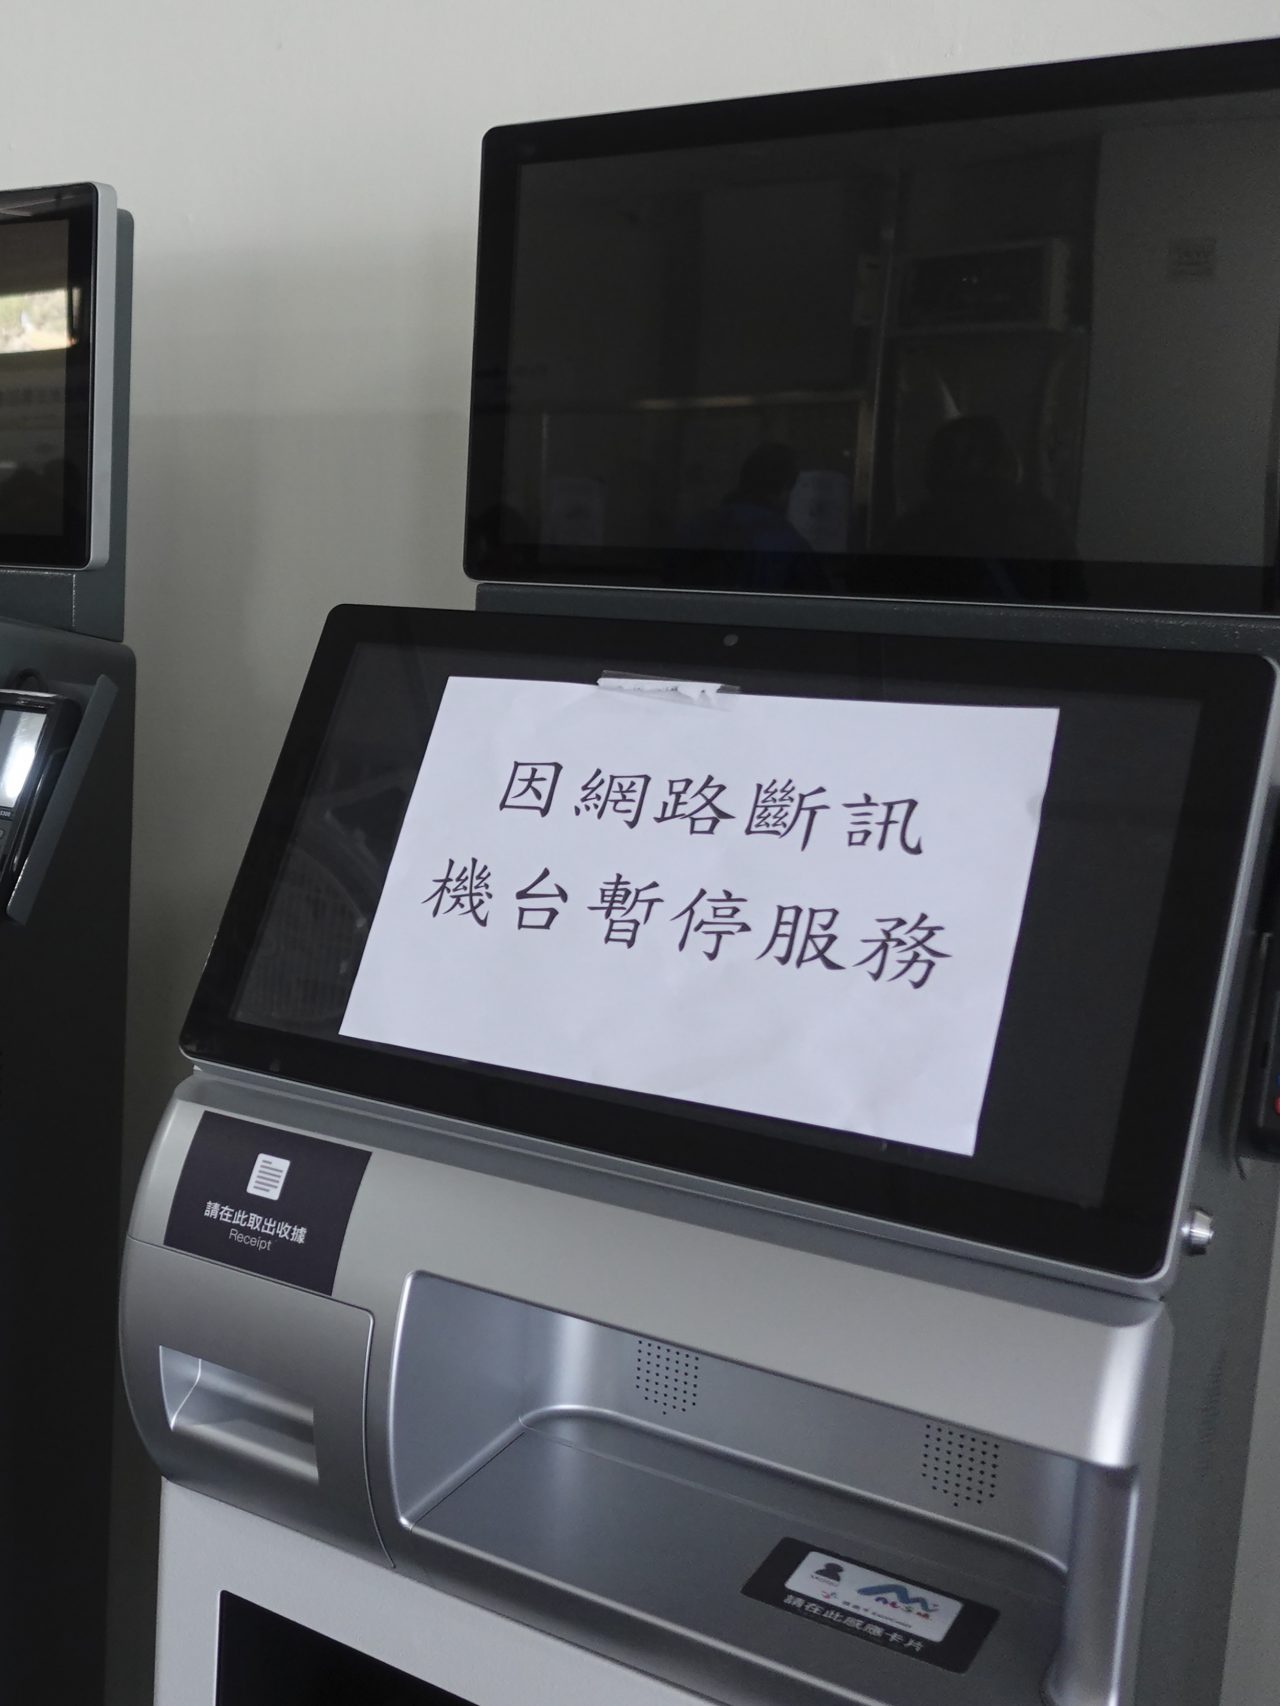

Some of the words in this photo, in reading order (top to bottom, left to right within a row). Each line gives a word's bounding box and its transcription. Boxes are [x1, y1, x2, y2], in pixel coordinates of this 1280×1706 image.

[499, 760, 924, 856] 因網路斷訊
[422, 857, 953, 990] 機台暫停服務
[204, 1200, 308, 1244] 請在此取出收據
[228, 1228, 273, 1251] Receipt
